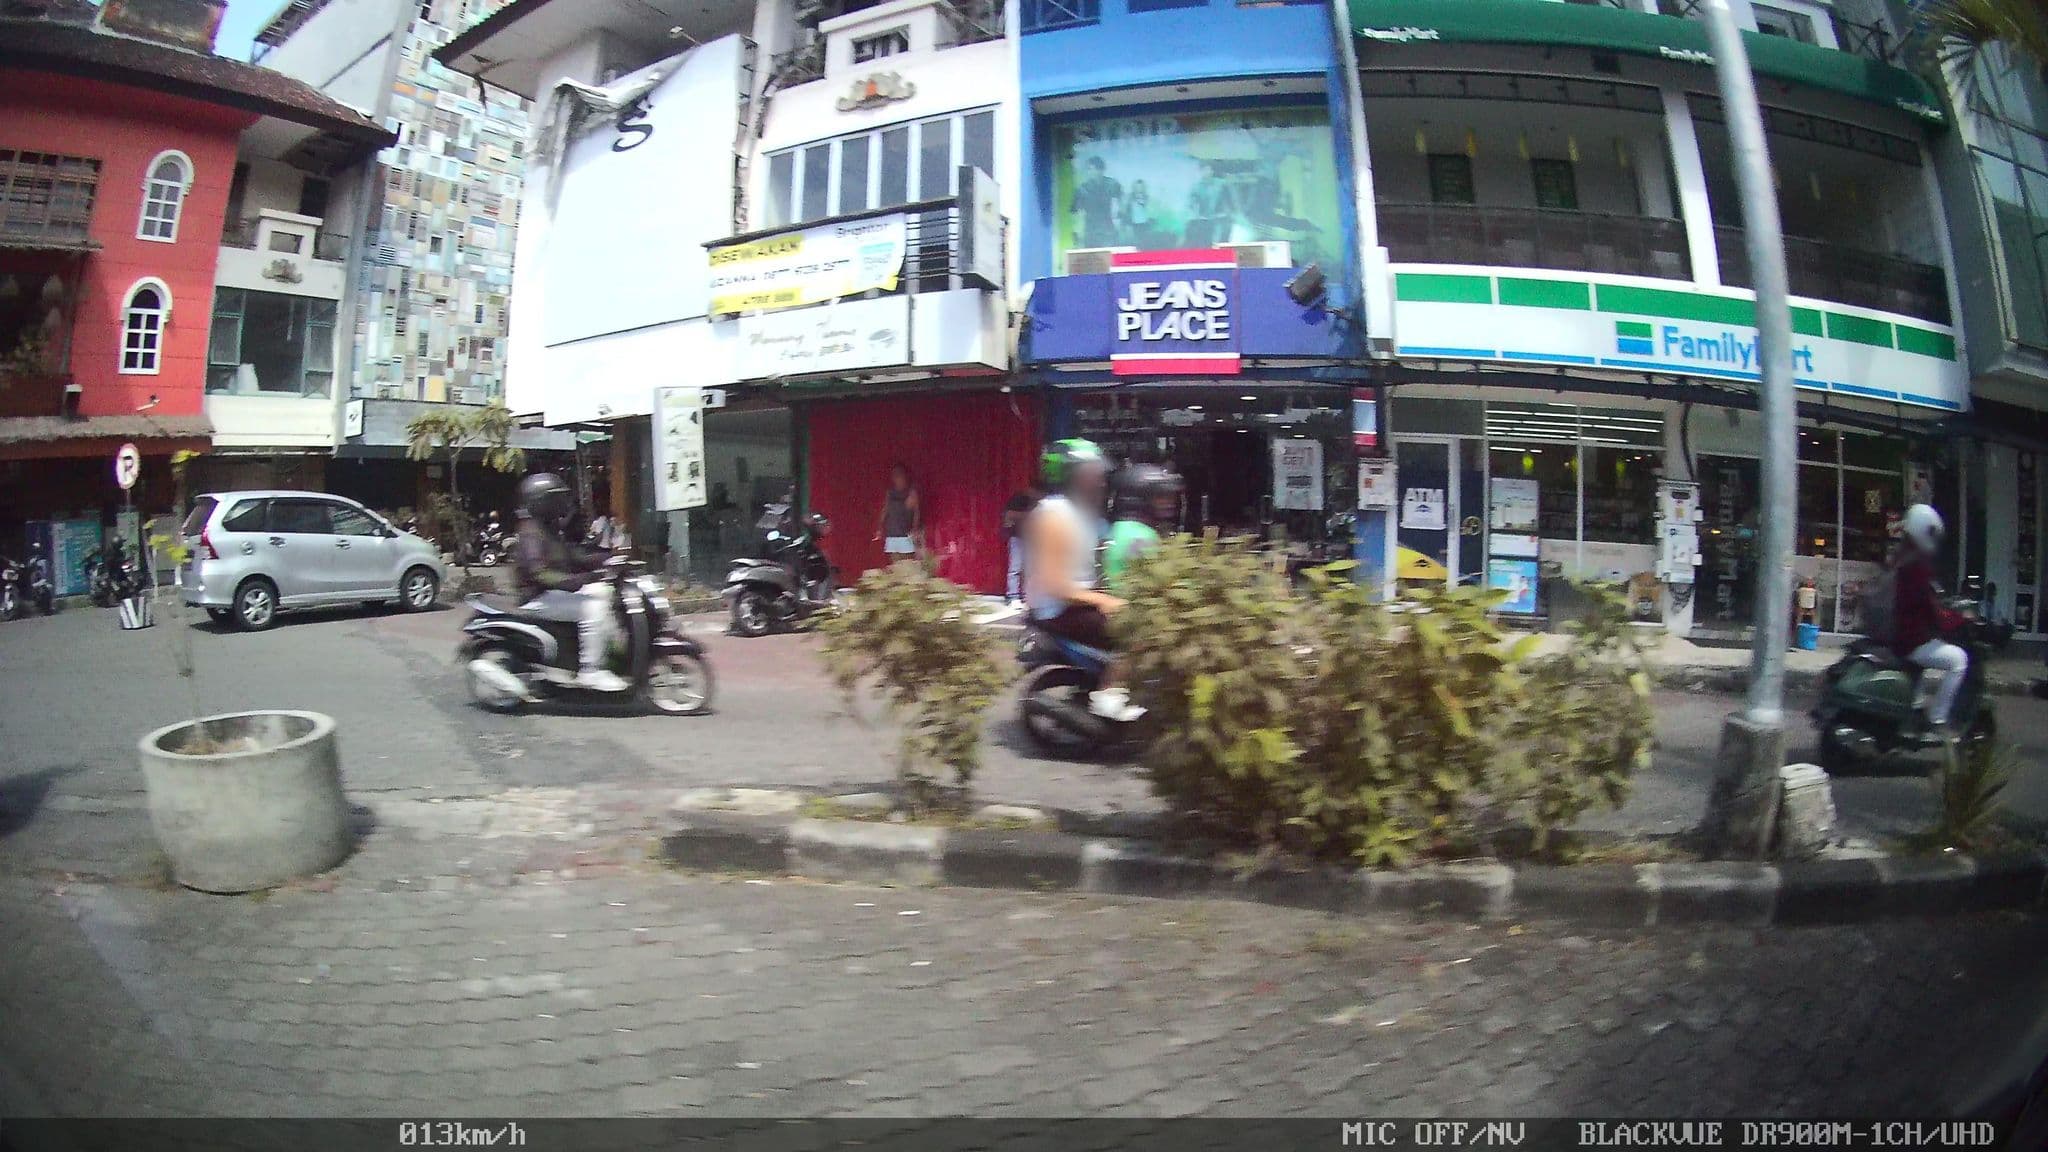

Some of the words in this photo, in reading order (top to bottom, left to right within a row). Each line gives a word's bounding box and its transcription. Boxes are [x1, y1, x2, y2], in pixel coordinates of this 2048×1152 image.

[1118, 279, 1227, 312] JEANS
[1117, 310, 1231, 341] PLACE
[1662, 325, 1814, 372] Familyrt
